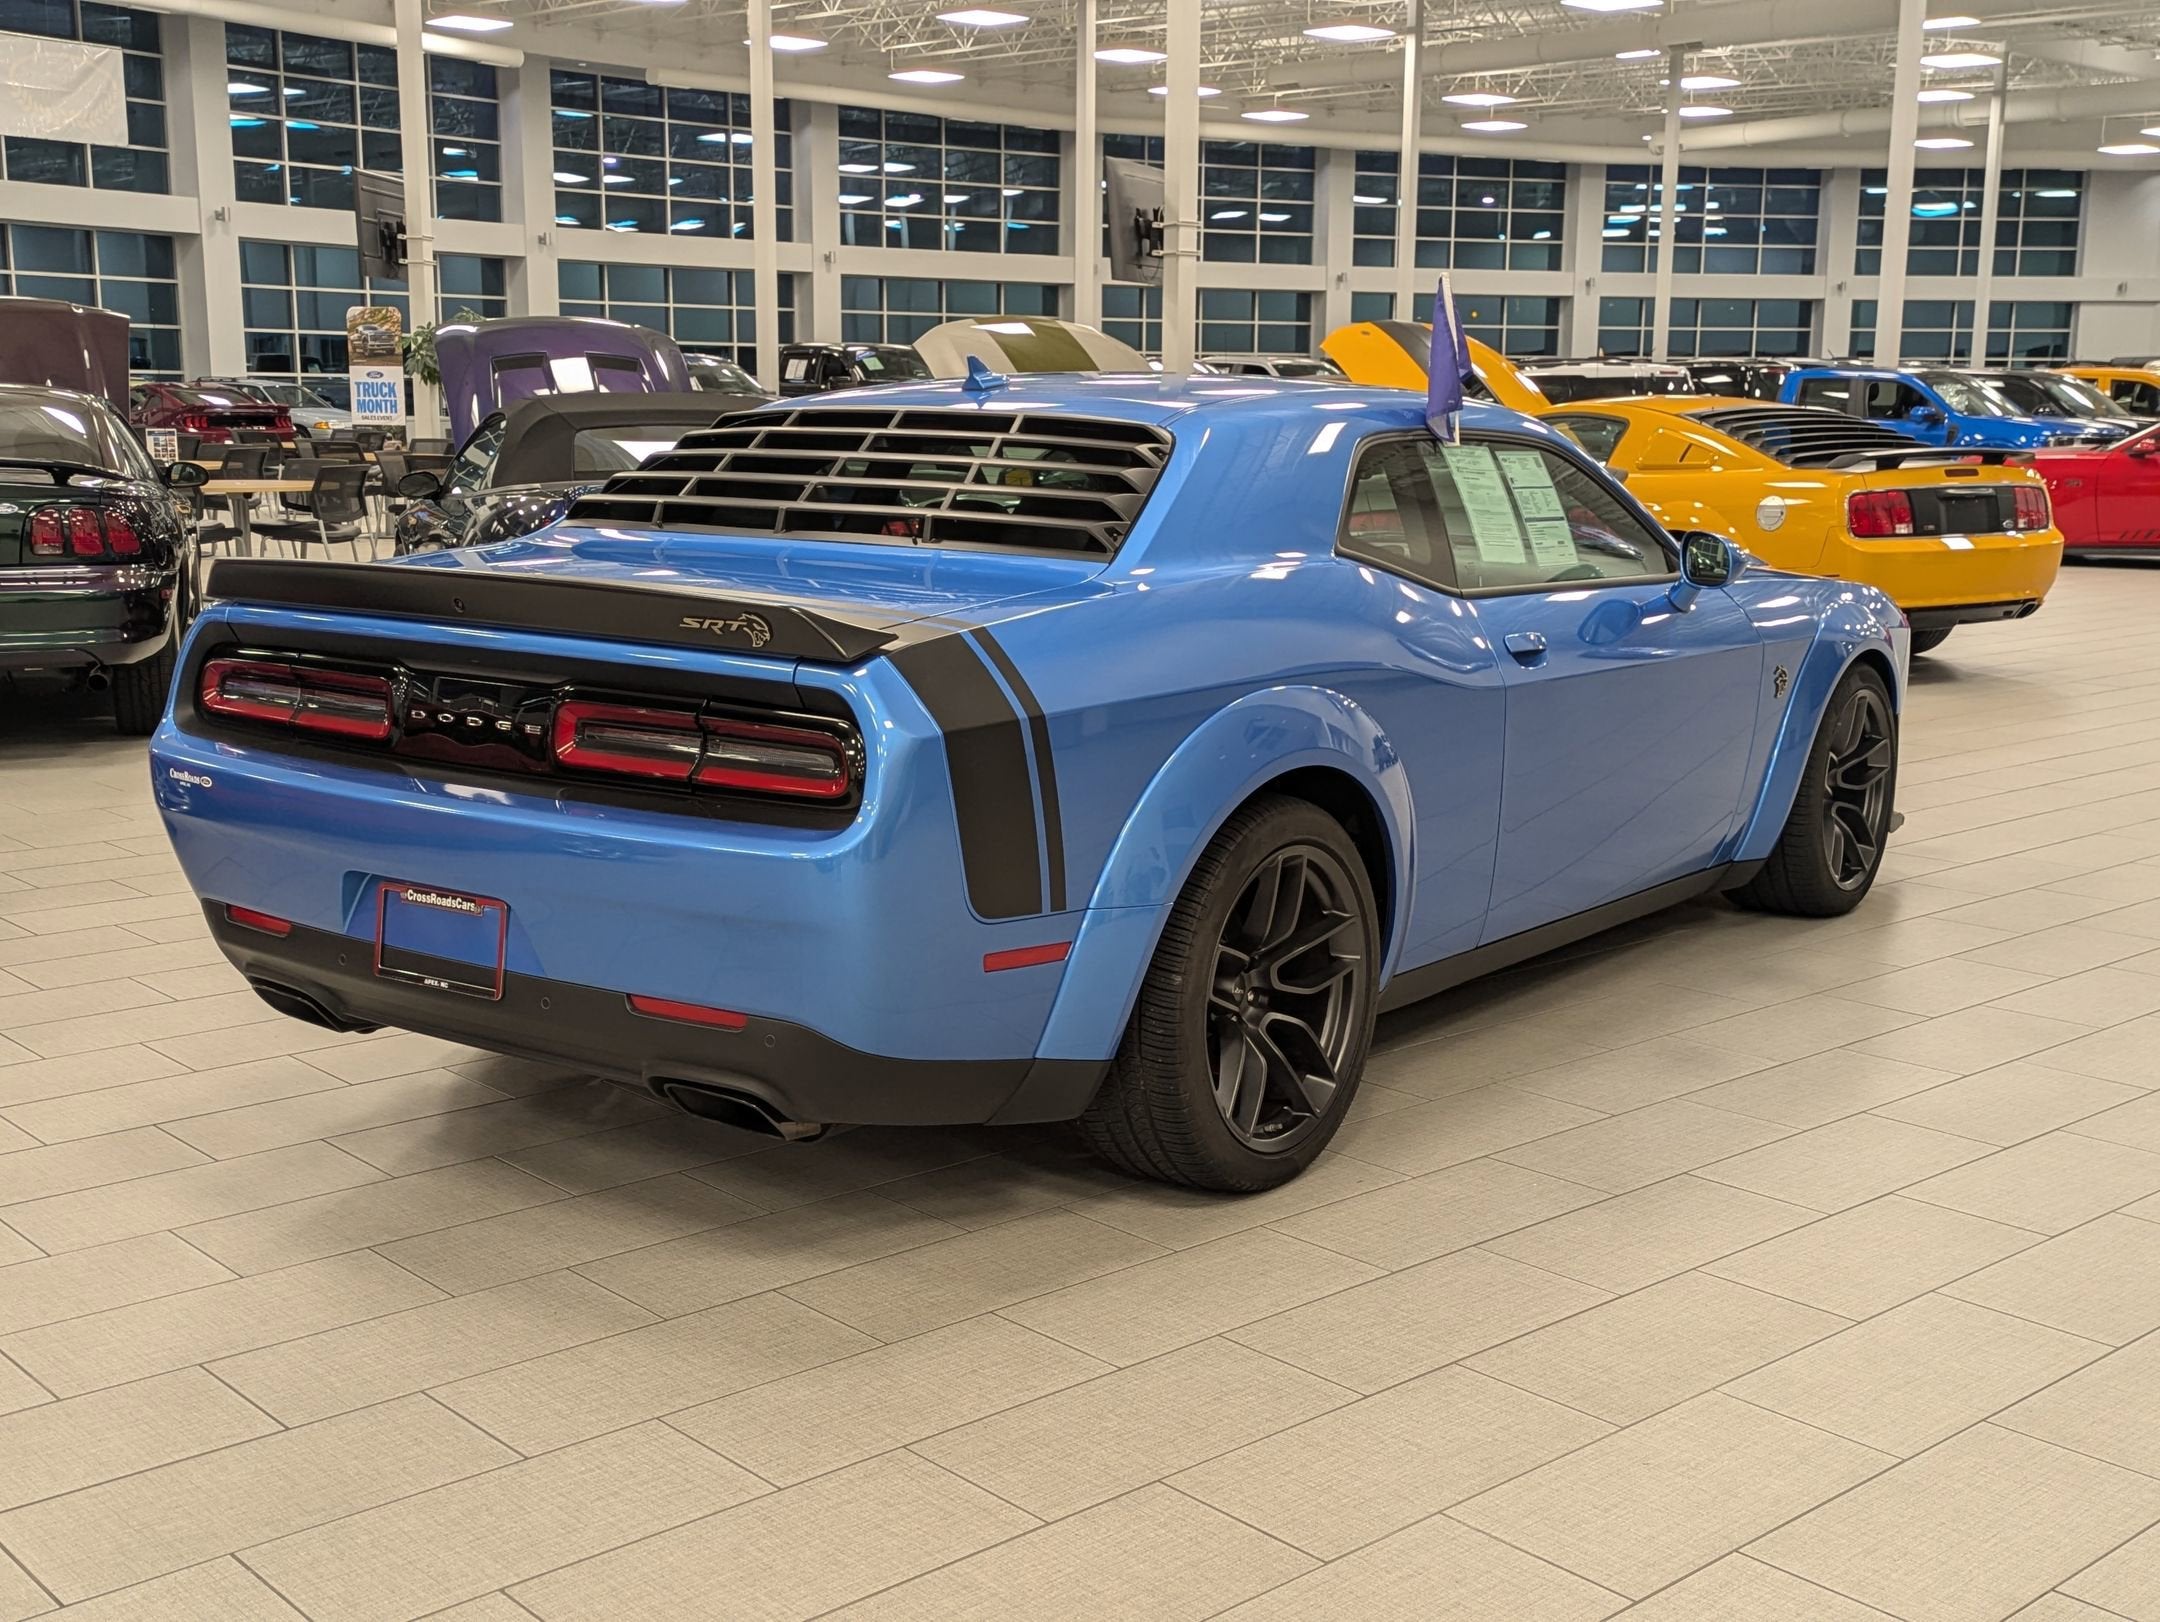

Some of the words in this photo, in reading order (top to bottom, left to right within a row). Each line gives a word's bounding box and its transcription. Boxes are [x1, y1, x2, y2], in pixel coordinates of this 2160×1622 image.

[354, 381, 397, 398] TRUCK
[356, 398, 398, 414] MONTH
[680, 617, 747, 635] SRT
[411, 709, 542, 735] DODGE
[407, 889, 476, 912] CrossRoadsCars
